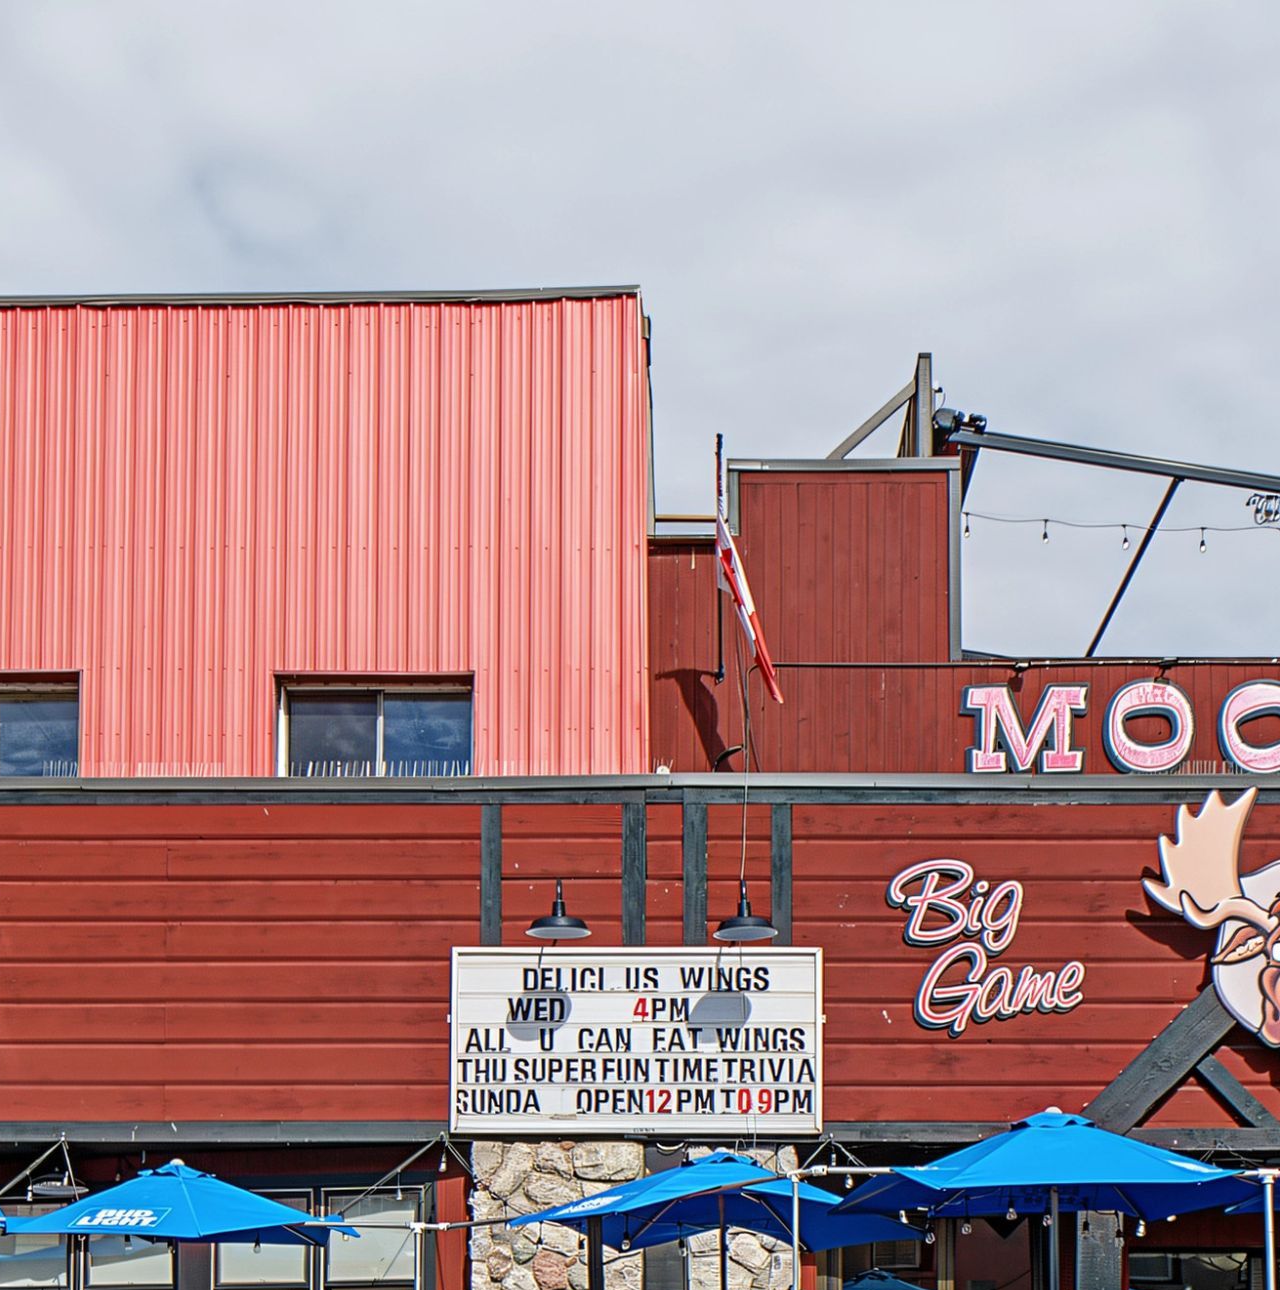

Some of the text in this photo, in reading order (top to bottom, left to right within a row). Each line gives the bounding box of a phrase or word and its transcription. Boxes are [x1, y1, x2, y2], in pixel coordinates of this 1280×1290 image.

[886, 858, 1025, 954] Big
[680, 966, 770, 992] WINGS
[914, 942, 1086, 1040] Game
[508, 997, 690, 1022] WED 4PM
[465, 1028, 806, 1053] ALL U CAN EAT WINGS
[458, 1058, 816, 1084] THU SUPER FUN TIME TRIVIA
[456, 1088, 541, 1114] SUNDA
[576, 1088, 645, 1114] OPEN
